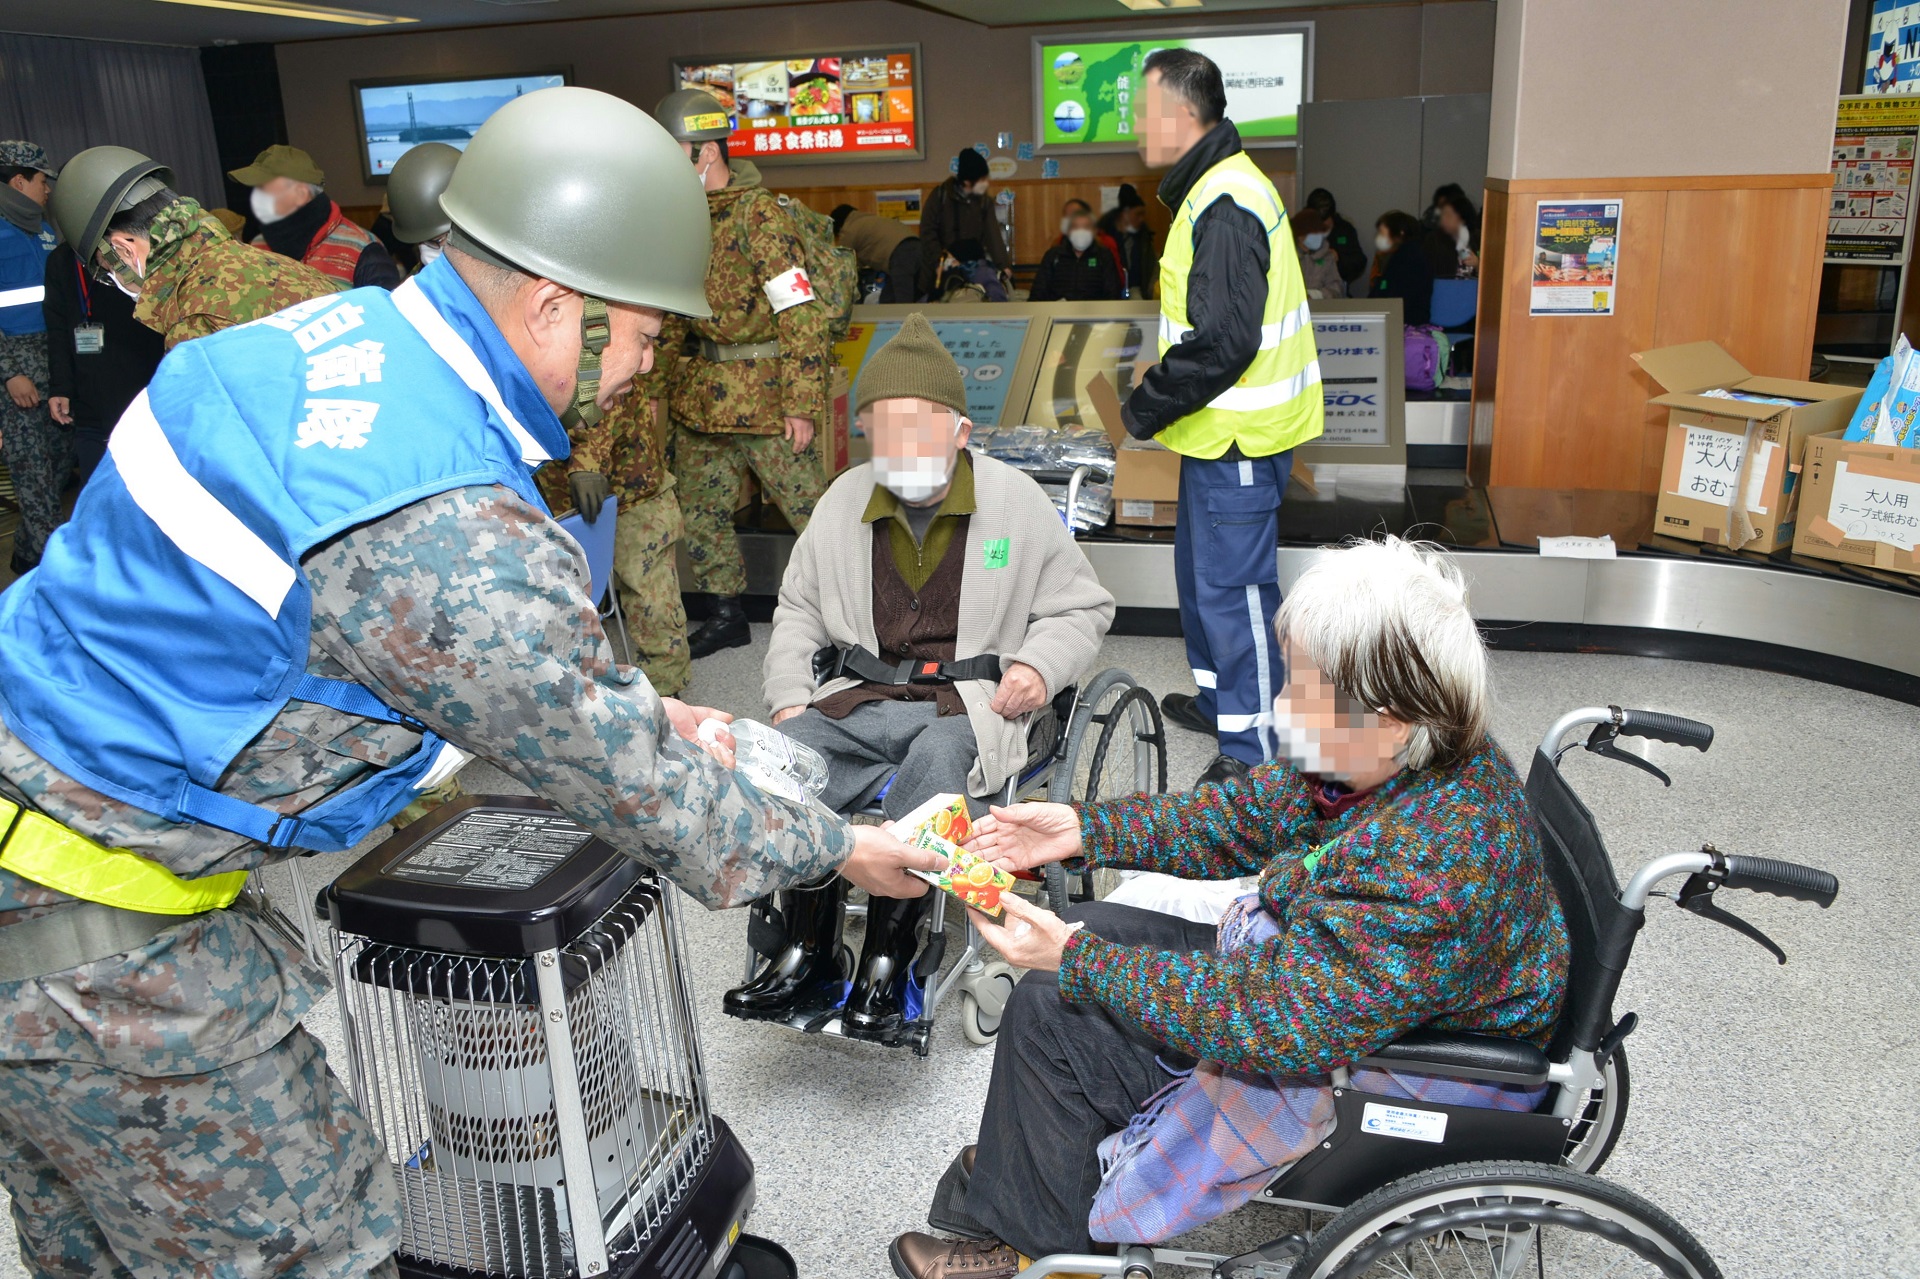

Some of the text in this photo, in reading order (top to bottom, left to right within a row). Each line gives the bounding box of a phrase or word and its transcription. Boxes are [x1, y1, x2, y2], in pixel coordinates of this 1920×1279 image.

[1838, 100, 1920, 110] の手荷物、危険物です
[1864, 488, 1909, 509] 大人用
